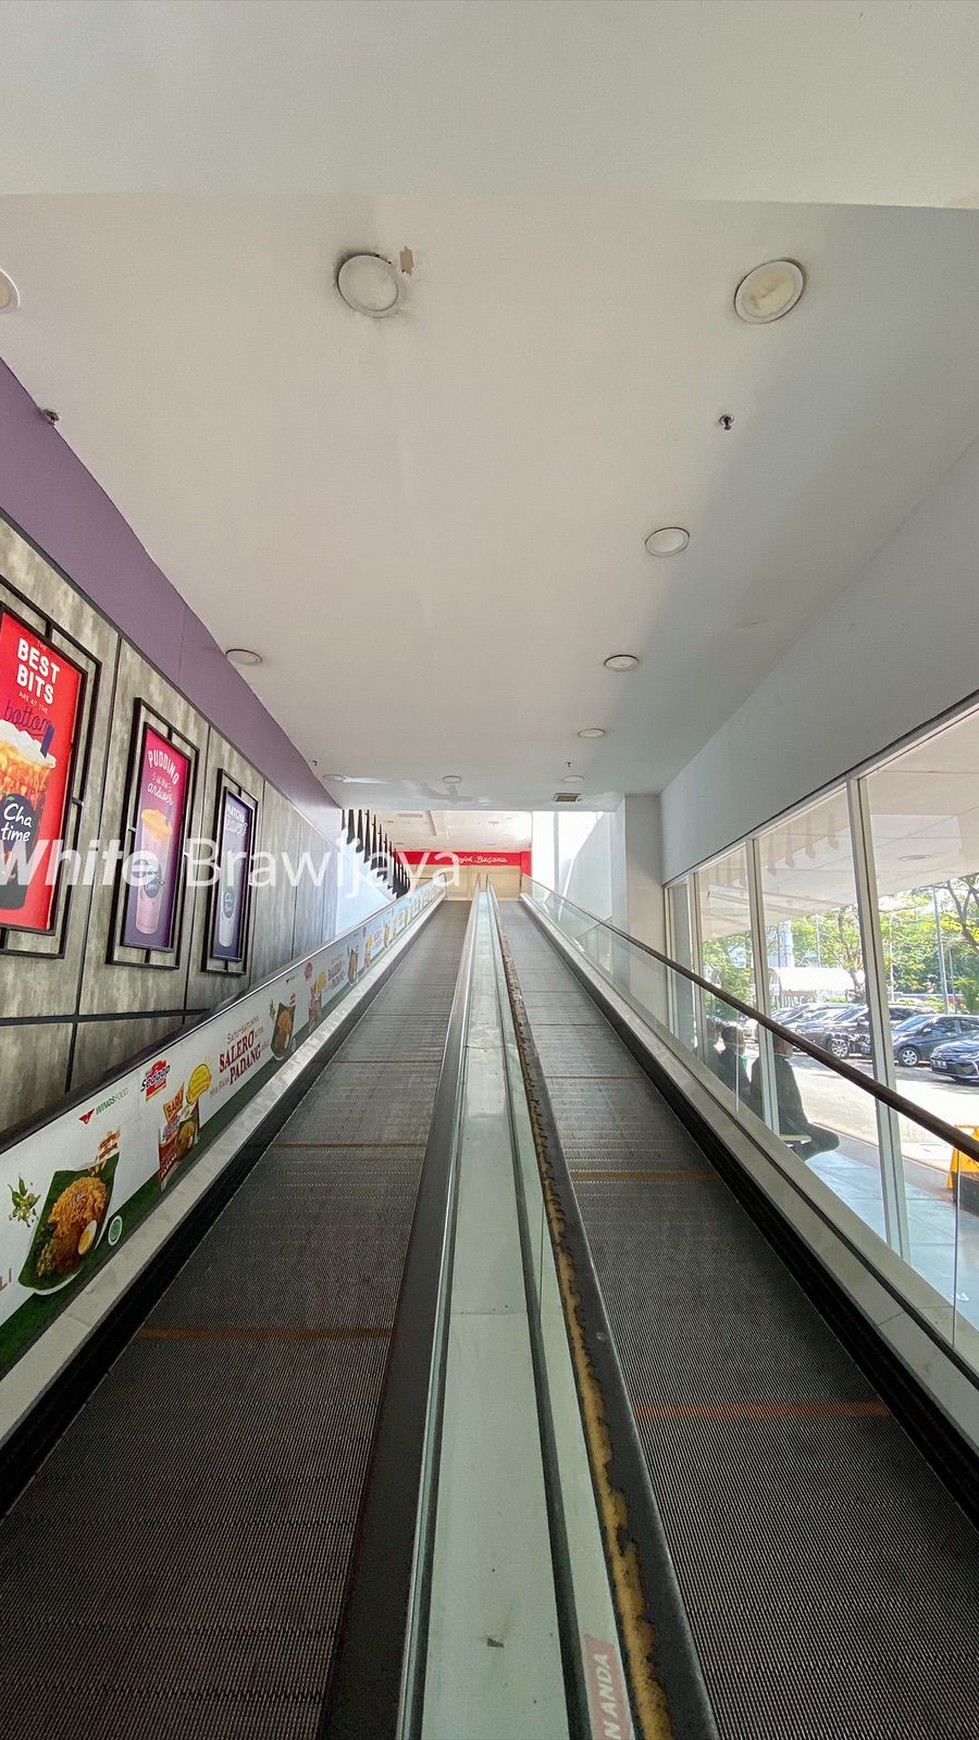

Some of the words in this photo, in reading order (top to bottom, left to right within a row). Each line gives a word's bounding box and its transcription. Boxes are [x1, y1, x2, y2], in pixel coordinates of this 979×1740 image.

[17, 637, 61, 684] BEST
[16, 663, 54, 705] BITS
[147, 749, 180, 785] PUDDING
[0, 822, 31, 842] time
[3, 803, 32, 828] Cha
[219, 1030, 255, 1073] SALERO
[229, 1043, 261, 1085] PADANG
[165, 1092, 182, 1118] BARU
[592, 1652, 619, 1719] ANDA
